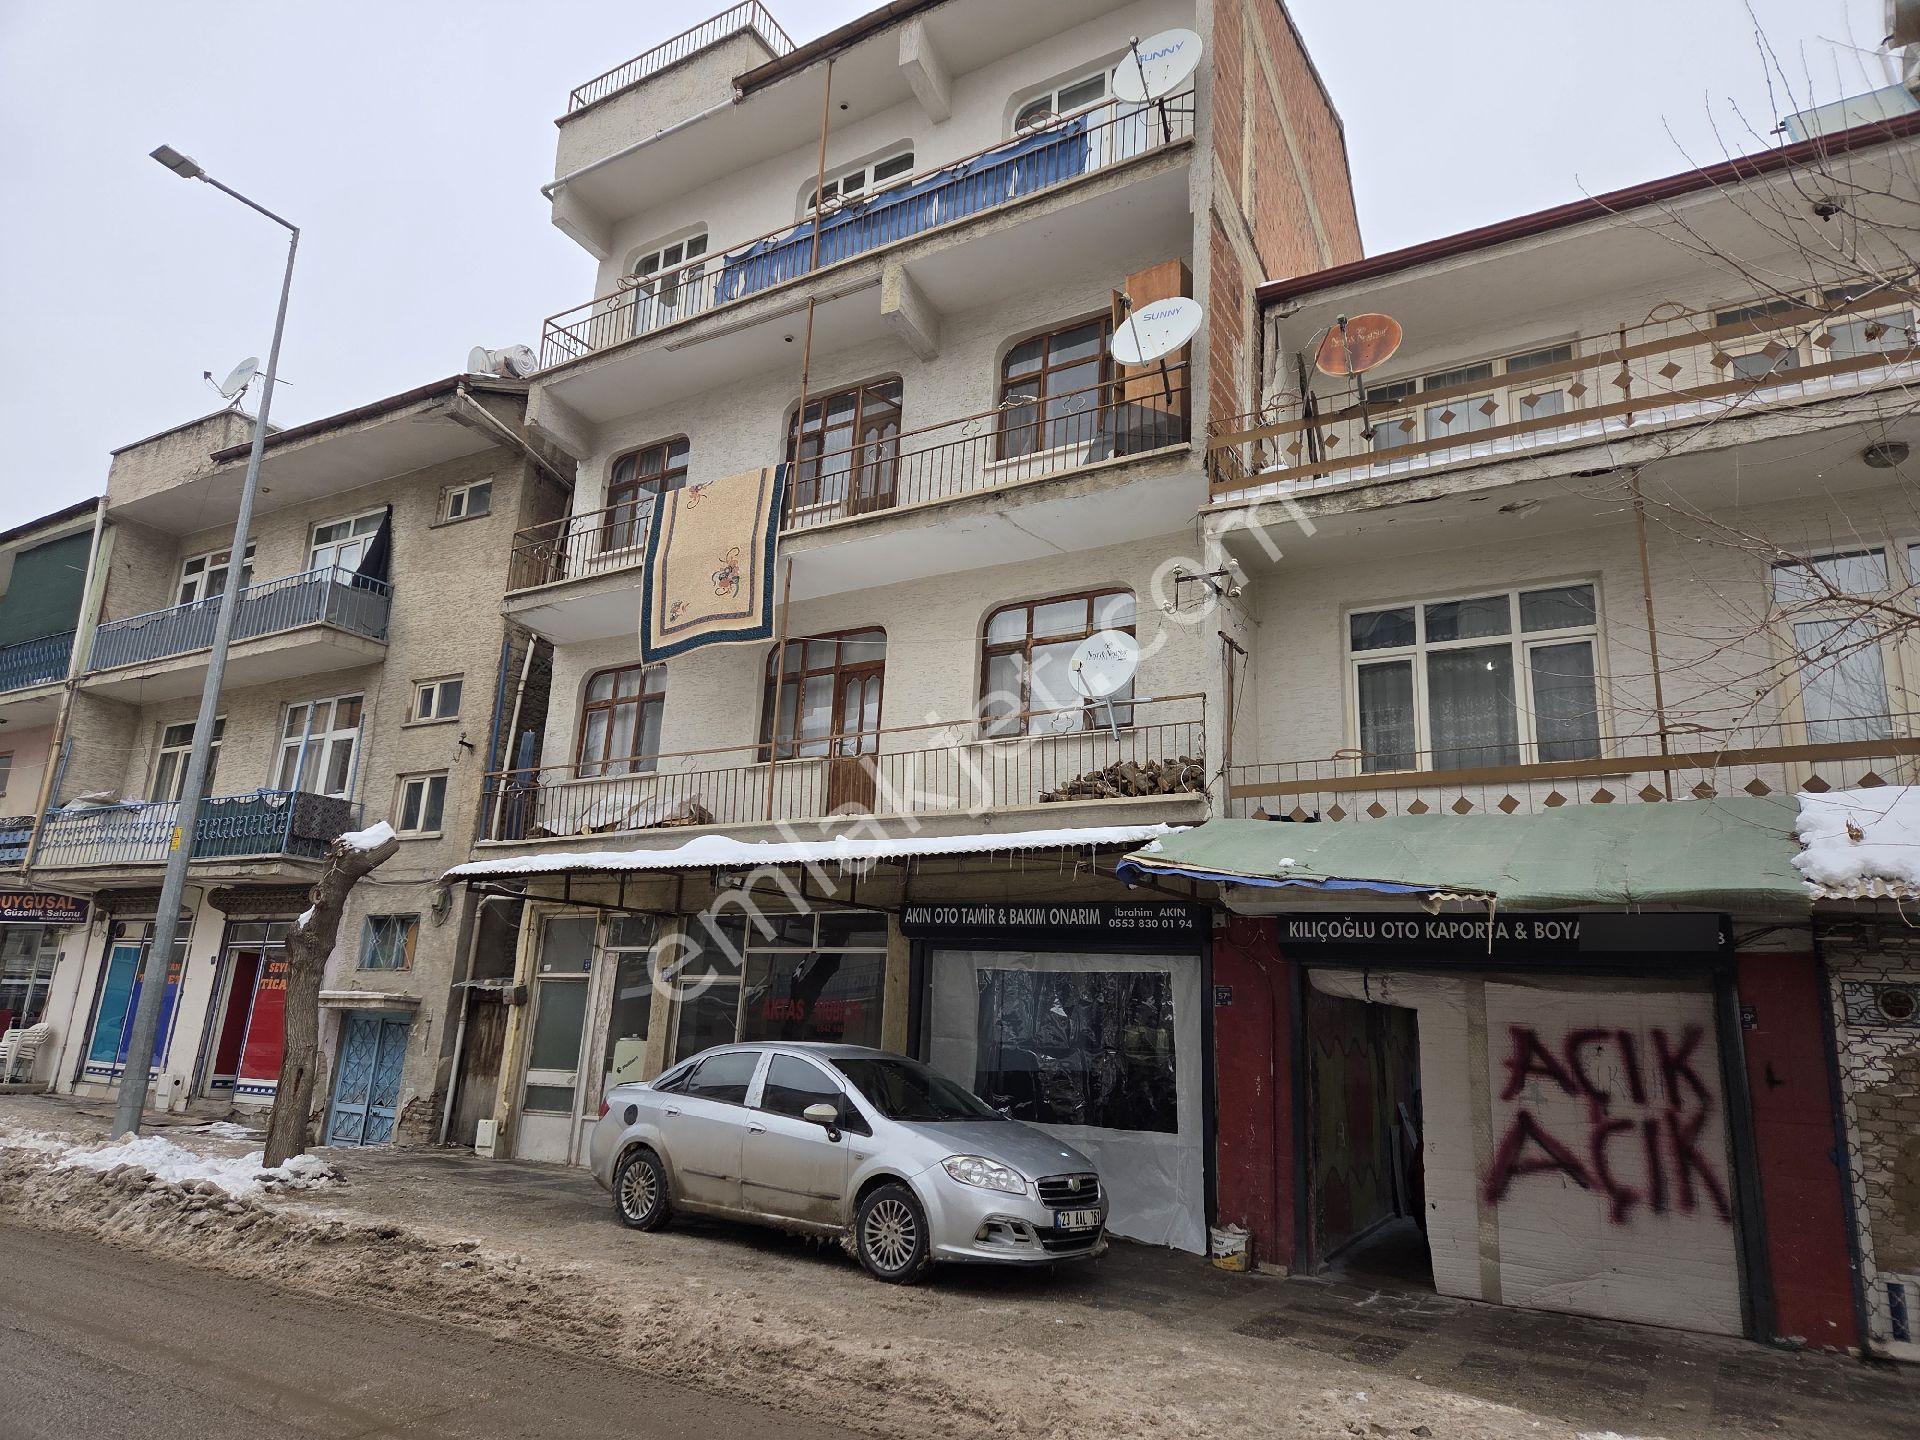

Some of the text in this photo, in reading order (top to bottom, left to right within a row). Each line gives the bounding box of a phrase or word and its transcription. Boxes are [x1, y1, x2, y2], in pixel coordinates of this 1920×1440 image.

[1139, 40, 1184, 62] SUNNY
[1143, 306, 1182, 321] SUNNY
[0, 895, 76, 910] UYGUSAL
[4, 908, 44, 917] Güzellik
[46, 910, 80, 918] Salonu
[905, 903, 1101, 926] AKIN OTO TAMİR & BAKIM ONARIM
[1159, 907, 1186, 917] AKIN
[1108, 918, 1193, 929] 0553 830 01 94
[1289, 916, 1376, 943] KILIÇOĞLU
[1381, 921, 1420, 939] OTO
[1425, 921, 1510, 940] KAPORTA
[1514, 922, 1528, 939] &
[260, 976, 288, 990] TİCA
[1061, 1212, 1070, 1227] 23
